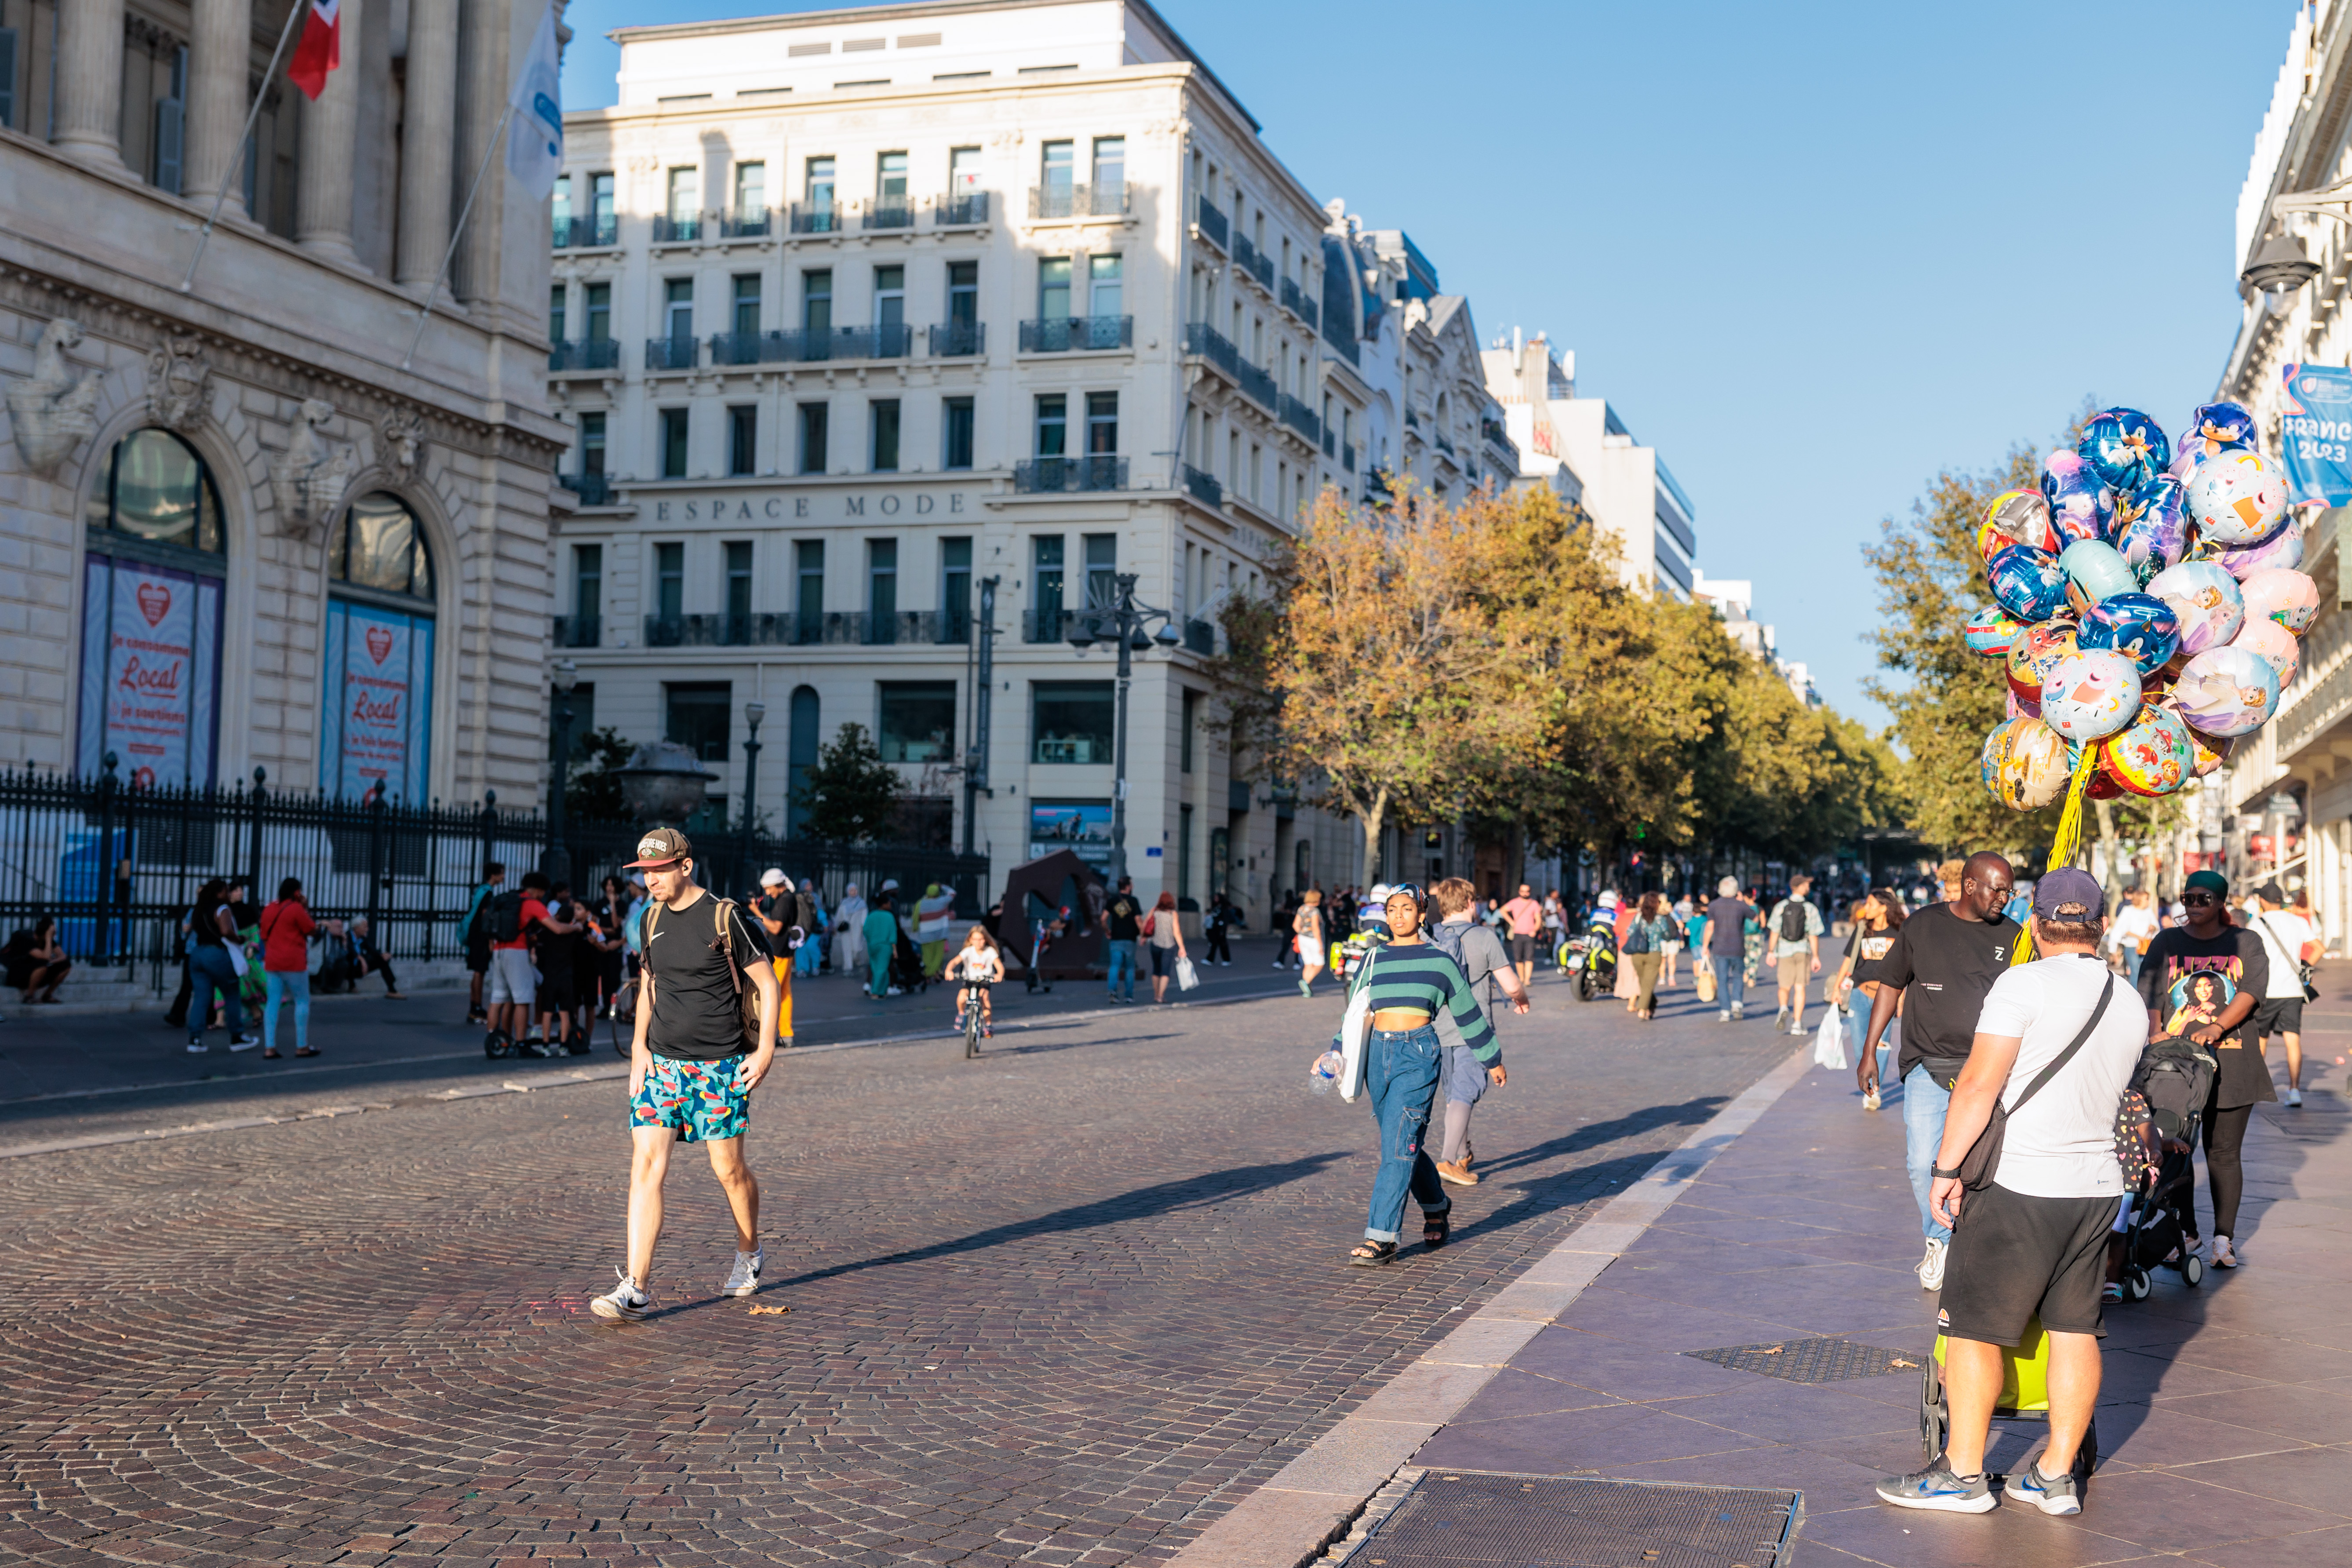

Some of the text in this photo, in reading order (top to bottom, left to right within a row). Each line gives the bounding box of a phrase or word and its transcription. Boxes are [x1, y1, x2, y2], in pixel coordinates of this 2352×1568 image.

[2298, 440, 2347, 463] 2023
[657, 493, 965, 520] ESPACE MODE
[118, 655, 181, 691] Local
[351, 691, 401, 722] Local
[2168, 955, 2243, 982] LIZZO
